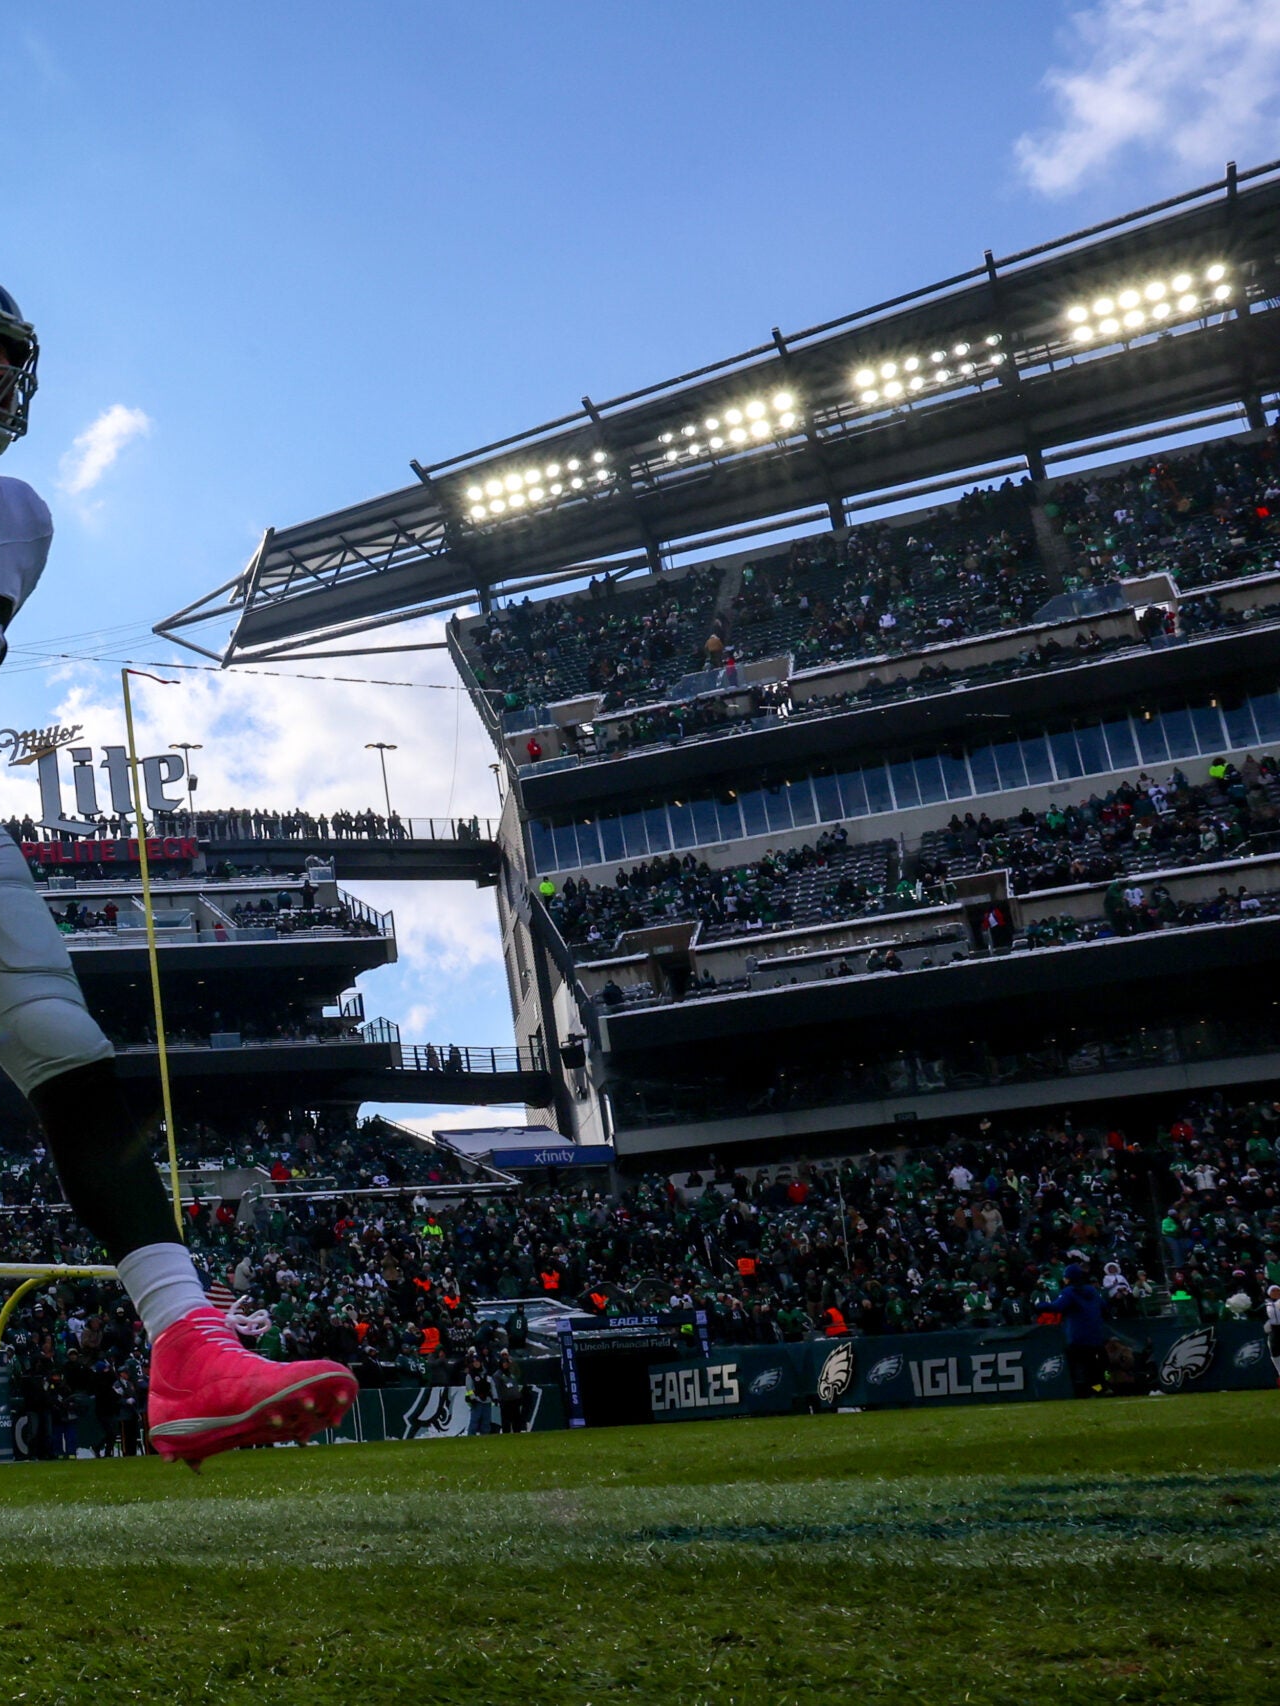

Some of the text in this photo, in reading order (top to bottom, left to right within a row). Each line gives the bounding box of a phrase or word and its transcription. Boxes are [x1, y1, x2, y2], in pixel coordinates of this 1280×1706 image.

[33, 745, 185, 836] Lite
[21, 837, 199, 864] PHLITE DECK
[534, 1149, 575, 1164] xfinity
[609, 1316, 658, 1327] EAGLES
[580, 1338, 671, 1352] Lincoln Financial Field
[566, 1348, 579, 1405] BIRDS
[649, 1363, 739, 1411] EAGLES
